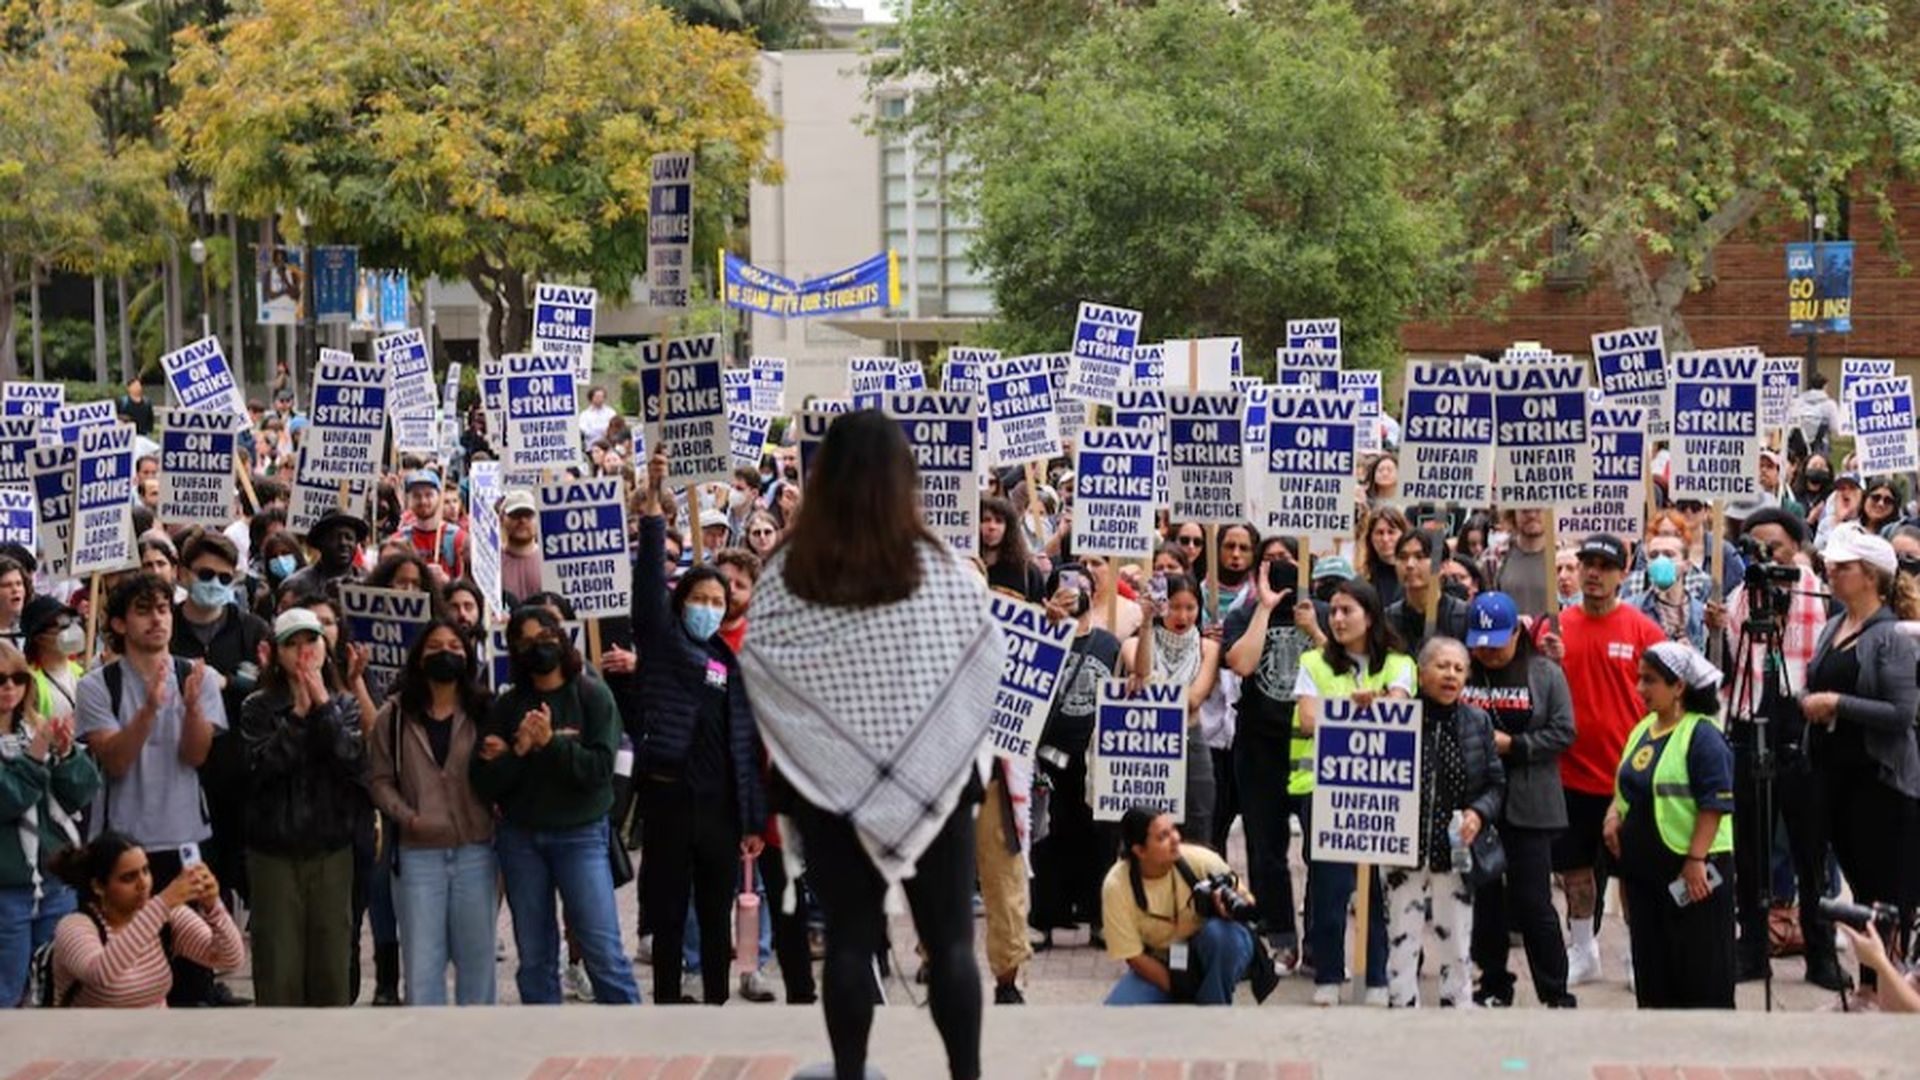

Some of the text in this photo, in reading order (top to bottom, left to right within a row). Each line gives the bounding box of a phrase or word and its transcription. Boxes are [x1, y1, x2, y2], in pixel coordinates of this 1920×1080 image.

[653, 157, 689, 180] UAW
[540, 287, 593, 305] UAW
[823, 281, 879, 308] STUDENTS
[1789, 278, 1814, 299] GO
[553, 309, 576, 323] ON
[1084, 306, 1137, 326] UAW
[538, 322, 590, 340] STRIKE
[1095, 327, 1118, 344] ON
[1290, 322, 1336, 336] UAW
[378, 332, 419, 351] UAW
[1599, 330, 1657, 351] UAW
[167, 340, 214, 370] UAW
[643, 338, 714, 363] UAW
[953, 350, 997, 363] UAW
[1077, 340, 1131, 362] STRIKE
[1283, 353, 1337, 367] UAW
[509, 357, 569, 373] UAW
[852, 360, 896, 371] UAW
[987, 359, 1041, 380] UAW
[1620, 352, 1646, 371] ON
[1676, 358, 1757, 379] UAW
[1845, 362, 1891, 374] UAW
[189, 361, 211, 382] ON
[321, 365, 386, 382] UAW
[667, 365, 697, 390] ON
[1414, 366, 1490, 386] UAW
[1495, 366, 1583, 390] UAW
[8, 385, 60, 398] UAW
[181, 372, 232, 403] STRIKE
[528, 379, 554, 394] ON
[1006, 381, 1030, 397] ON
[1604, 371, 1665, 393] STRIKE
[1855, 380, 1908, 397] UAW
[337, 388, 365, 404] ON
[511, 395, 573, 415] STRIKE
[647, 387, 720, 417] SRIKE
[893, 396, 970, 414] UAW
[1171, 395, 1238, 415] UAW
[1435, 393, 1468, 416] ON
[1700, 386, 1731, 408] ON
[1872, 397, 1894, 414] ON
[22, 402, 45, 417] ON
[60, 403, 111, 423] UAW
[316, 406, 380, 426] STRIKE
[991, 397, 1050, 418] STRIKE
[1272, 398, 1354, 419] UAW
[1523, 396, 1557, 419] ON
[167, 413, 232, 429] UAW
[520, 420, 567, 434] UNFAIR
[1408, 415, 1491, 439] STRIKE
[1591, 409, 1642, 428] AW
[1676, 411, 1754, 433] STRIKE
[1857, 413, 1911, 431] STRIKE
[322, 431, 372, 445] UNFAIR
[914, 422, 947, 442] ON
[1191, 422, 1217, 441] ON
[1295, 427, 1328, 448] ON
[1499, 419, 1584, 441] STRIKE
[83, 429, 130, 453] UAW
[184, 434, 212, 451] ON
[523, 433, 566, 448] LABOR
[1084, 430, 1153, 450] UAW
[1685, 439, 1744, 457] UNFAIR
[165, 452, 231, 470] STRIKE
[323, 445, 368, 459] LABOR
[514, 447, 576, 463] PRACTICE
[1173, 443, 1241, 463] STRIKE
[1272, 449, 1352, 472] STRIKE
[1417, 447, 1478, 463] UNFAIR
[1510, 447, 1576, 465] UNFAIR
[95, 456, 118, 479] ON
[311, 459, 375, 475] PRACTICE
[1102, 456, 1131, 474] ON
[1419, 466, 1473, 480] LABOR
[1514, 465, 1574, 482] LABOR
[1687, 457, 1740, 473] LABOR
[171, 476, 222, 489] UNFAIR
[923, 475, 961, 490] FAIR
[1080, 475, 1152, 496] STRIKE
[1182, 470, 1233, 484] UNFAIR
[1280, 476, 1341, 494] UNFAIR
[1675, 476, 1754, 493] PRACTICE
[79, 479, 130, 505] STRIKE
[173, 490, 219, 503] LABOR
[541, 481, 617, 505] UAW
[924, 493, 957, 508] BOR
[1184, 485, 1231, 500] LABOR
[1403, 482, 1485, 500] PRACTICE
[1502, 482, 1588, 500] PRACTICE
[1593, 484, 1628, 499] FAIR
[162, 504, 228, 518] PRACTICE
[1087, 503, 1142, 518] UNFAIR
[1174, 502, 1243, 517] PRACTICE
[1283, 494, 1337, 511] LABOR
[565, 510, 598, 530] ON
[1089, 519, 1138, 534] LABOR
[1269, 512, 1350, 530] PRACTICE
[1559, 517, 1637, 532] PRACTICE
[544, 529, 622, 560] STRIKE
[1077, 534, 1149, 550] PRACTICE
[76, 541, 125, 565] PRACTICE
[556, 560, 615, 579] UNFAIR
[561, 577, 613, 596] LABOR
[344, 591, 424, 617] UAW
[569, 592, 629, 612] ACTICE
[990, 599, 1072, 641] UAW
[372, 622, 402, 644] ON
[1103, 682, 1180, 702] UAW
[994, 690, 1034, 717] FAIR
[1324, 700, 1415, 725] UAW
[990, 708, 1024, 734] BOR
[1124, 709, 1157, 731] ON
[1101, 730, 1181, 754] STRIKE
[1348, 731, 1386, 756] ON
[1110, 762, 1169, 778] UNFAIR
[1320, 755, 1413, 785] STRIKE
[1112, 779, 1165, 795] LABOR
[1330, 791, 1399, 812] UNFAIR
[1334, 812, 1395, 832] LABOR
[1318, 831, 1410, 855] PRACTICE
